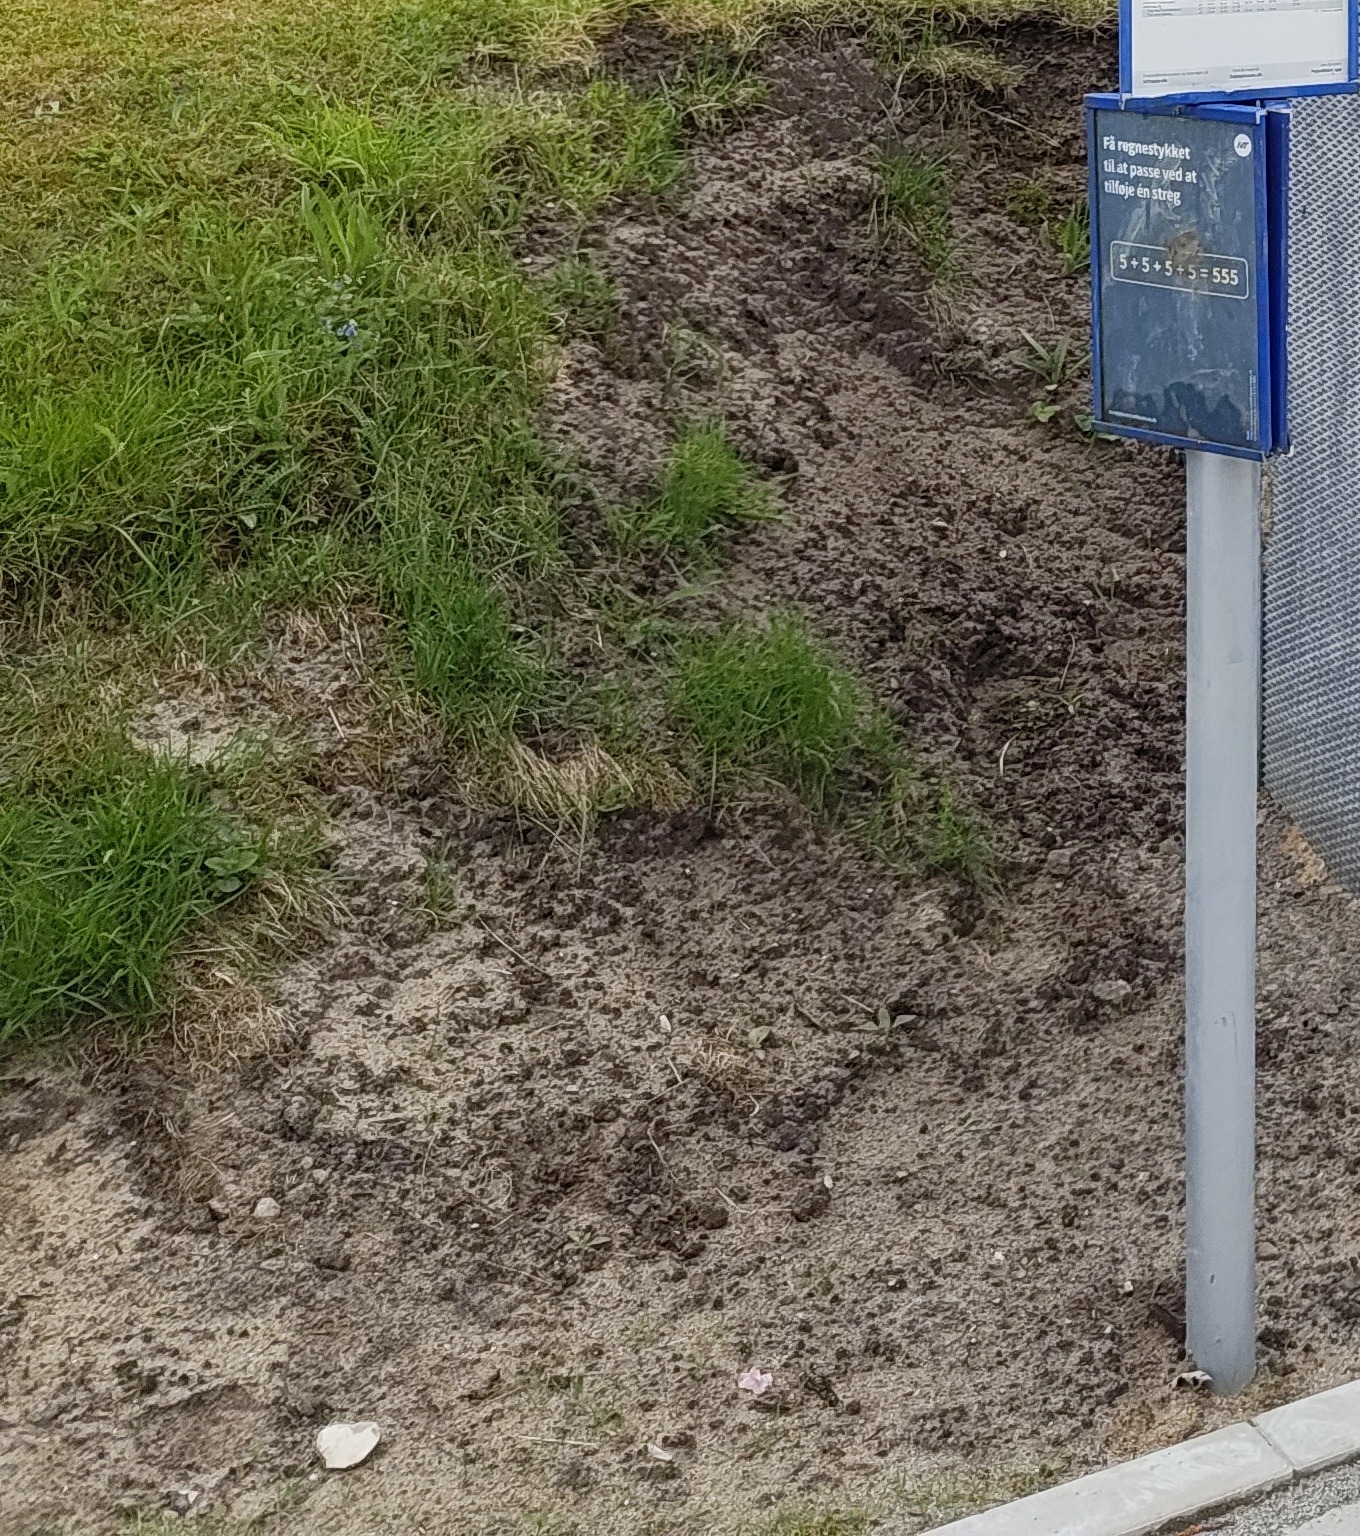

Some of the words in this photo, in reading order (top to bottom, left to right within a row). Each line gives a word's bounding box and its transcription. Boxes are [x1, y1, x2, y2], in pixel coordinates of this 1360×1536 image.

[1103, 135, 1116, 151] Få
[1117, 141, 1191, 160] regnestykket
[1103, 159, 1117, 173] til
[1116, 162, 1128, 175] at
[1129, 166, 1161, 179] passe
[1161, 167, 1183, 181] ved
[1185, 170, 1198, 184] at
[1104, 180, 1135, 200] tilføje
[1136, 183, 1150, 198] én
[1151, 188, 1181, 206] streg
[1120, 254, 1127, 269] 5
[1141, 257, 1149, 272] 5
[1164, 261, 1172, 276] 5
[1187, 265, 1196, 279] 5
[1211, 267, 1239, 285] 555
